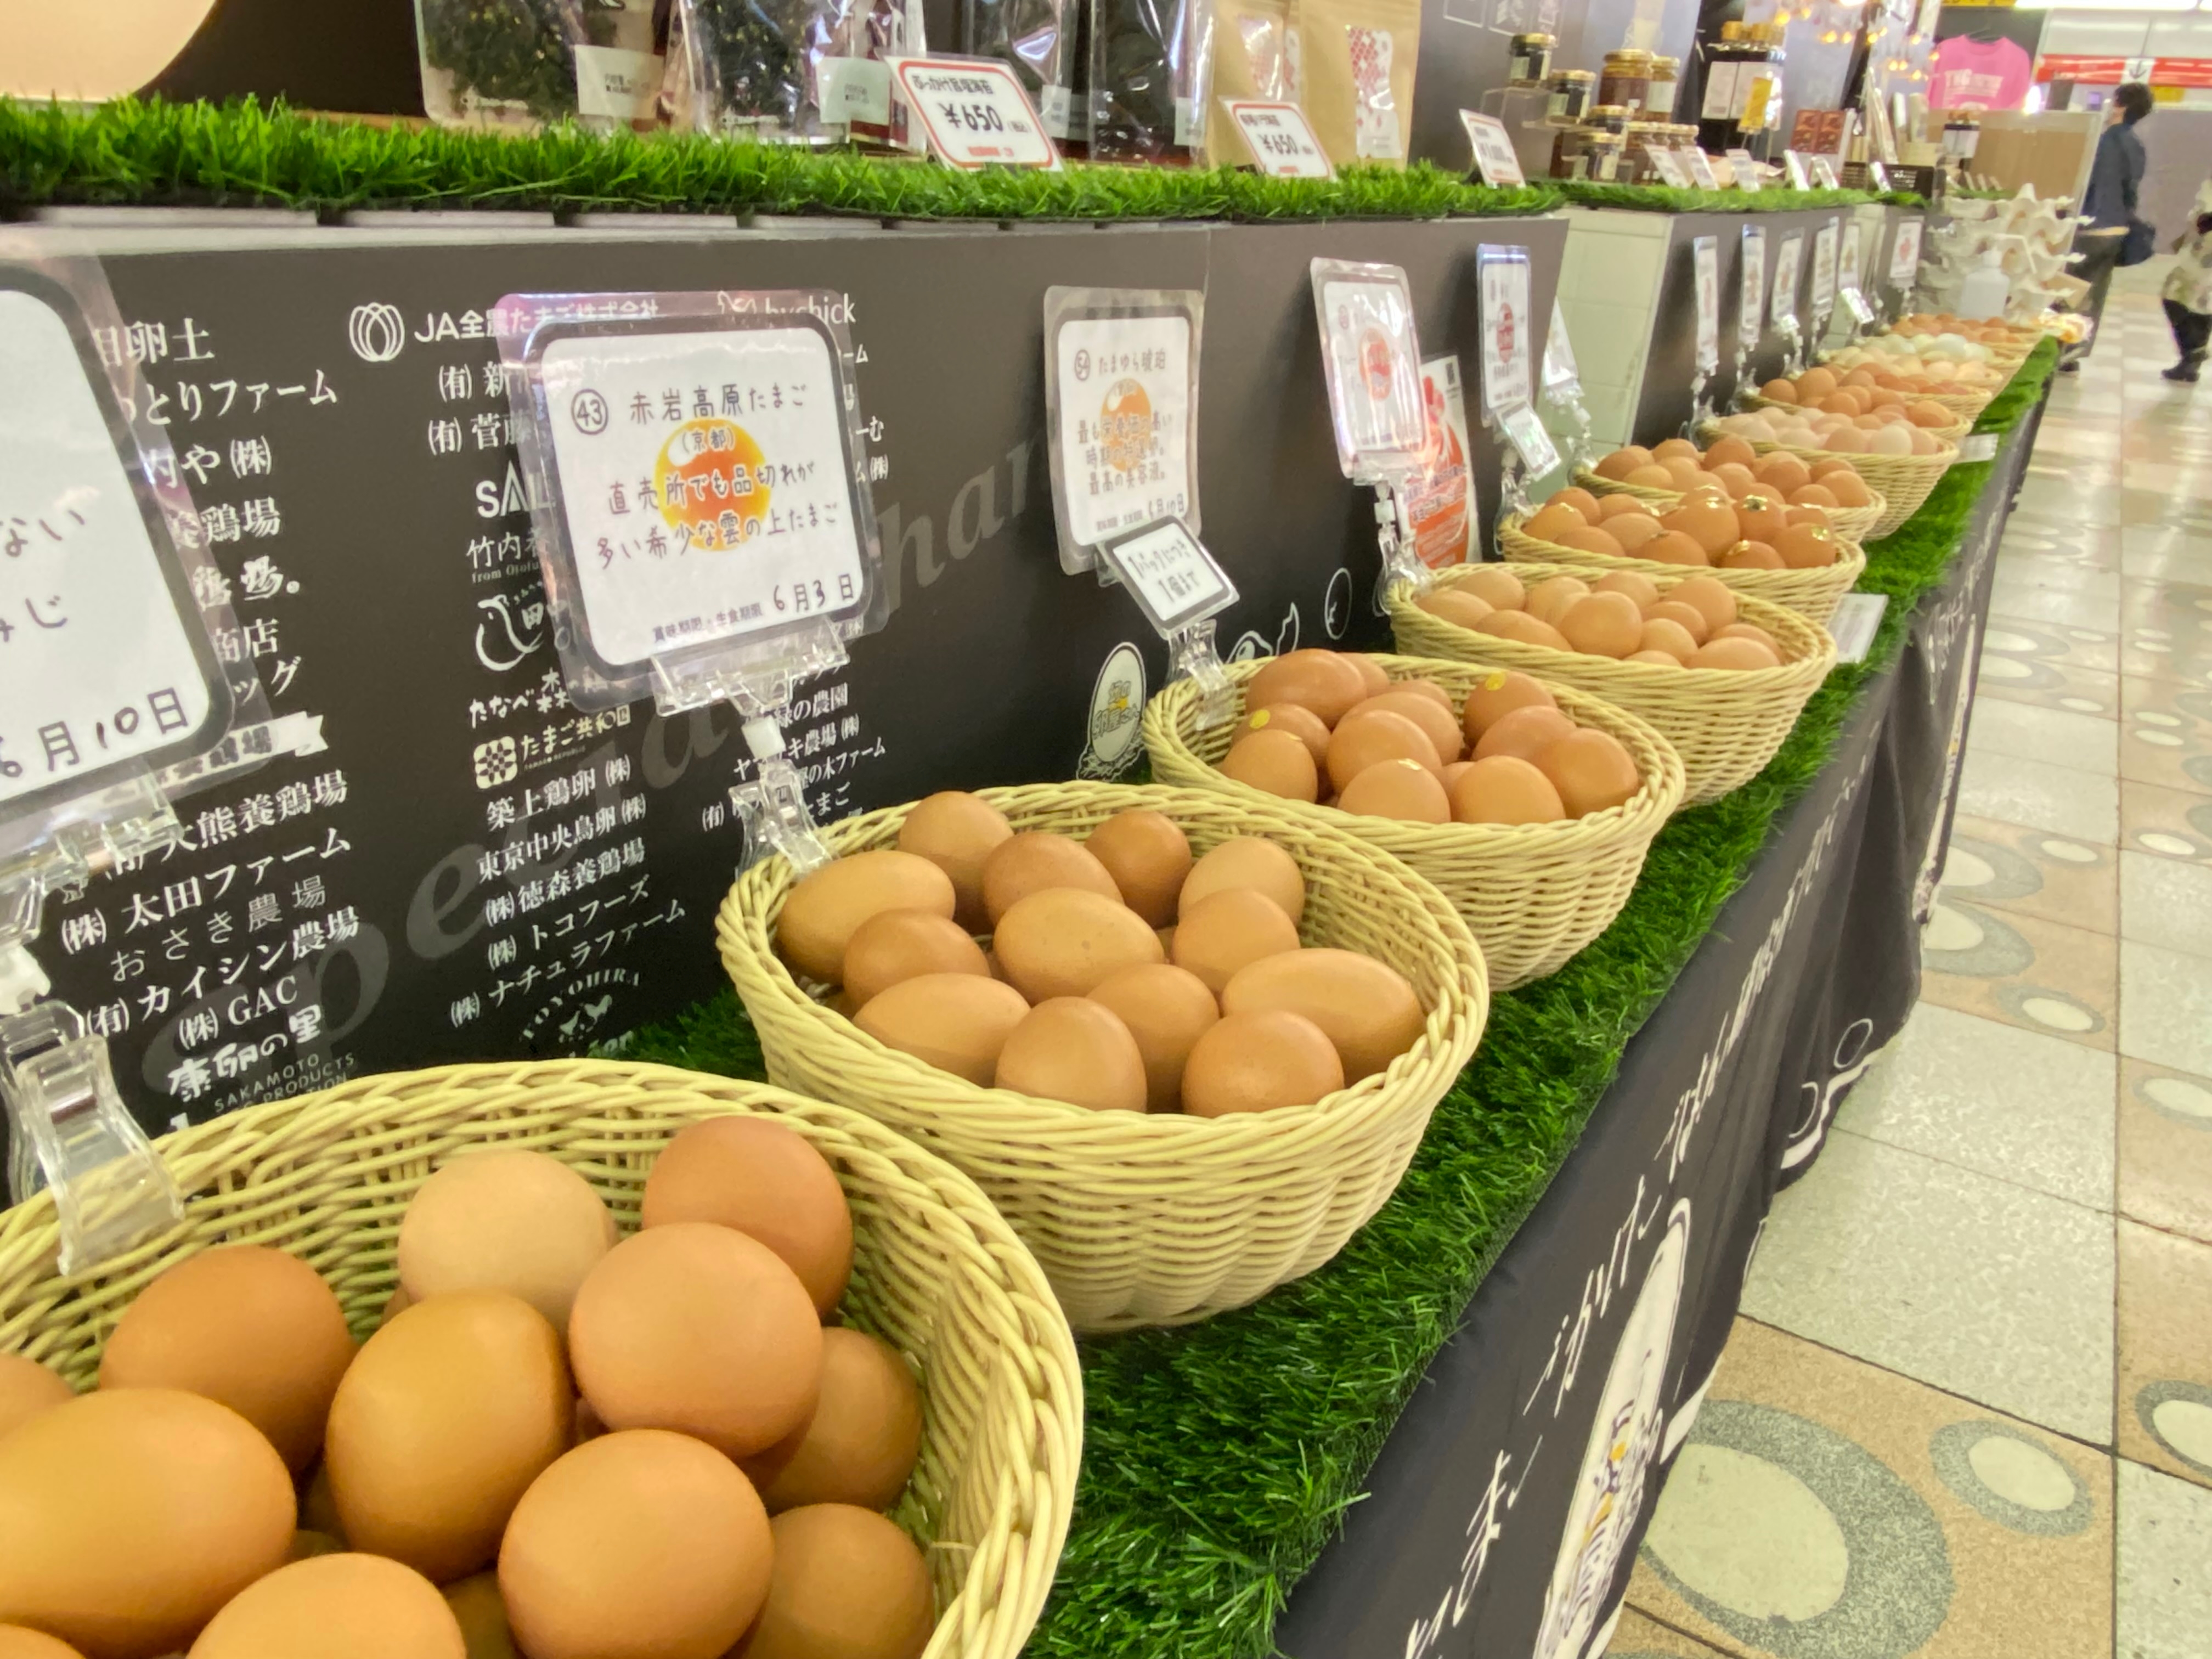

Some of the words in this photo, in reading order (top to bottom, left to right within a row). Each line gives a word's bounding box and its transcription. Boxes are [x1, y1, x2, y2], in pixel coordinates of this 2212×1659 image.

[938, 102, 1003, 132] ¥650
[1257, 134, 1299, 155] ¥650
[630, 383, 808, 426] 赤岩高原たまご
[681, 427, 735, 454] (京都)
[608, 460, 815, 516] 直売所でも品切れが
[597, 501, 838, 571] 多い希少な雲の上たまご
[121, 827, 352, 934] 太田ファーム
[532, 873, 650, 951] トコフーズ
[138, 905, 360, 1022] カイシン農場
[488, 898, 685, 1007] ナチュラファーム
[228, 975, 298, 1025] GAC
[214, 1053, 320, 1113] SAKAMOTO
